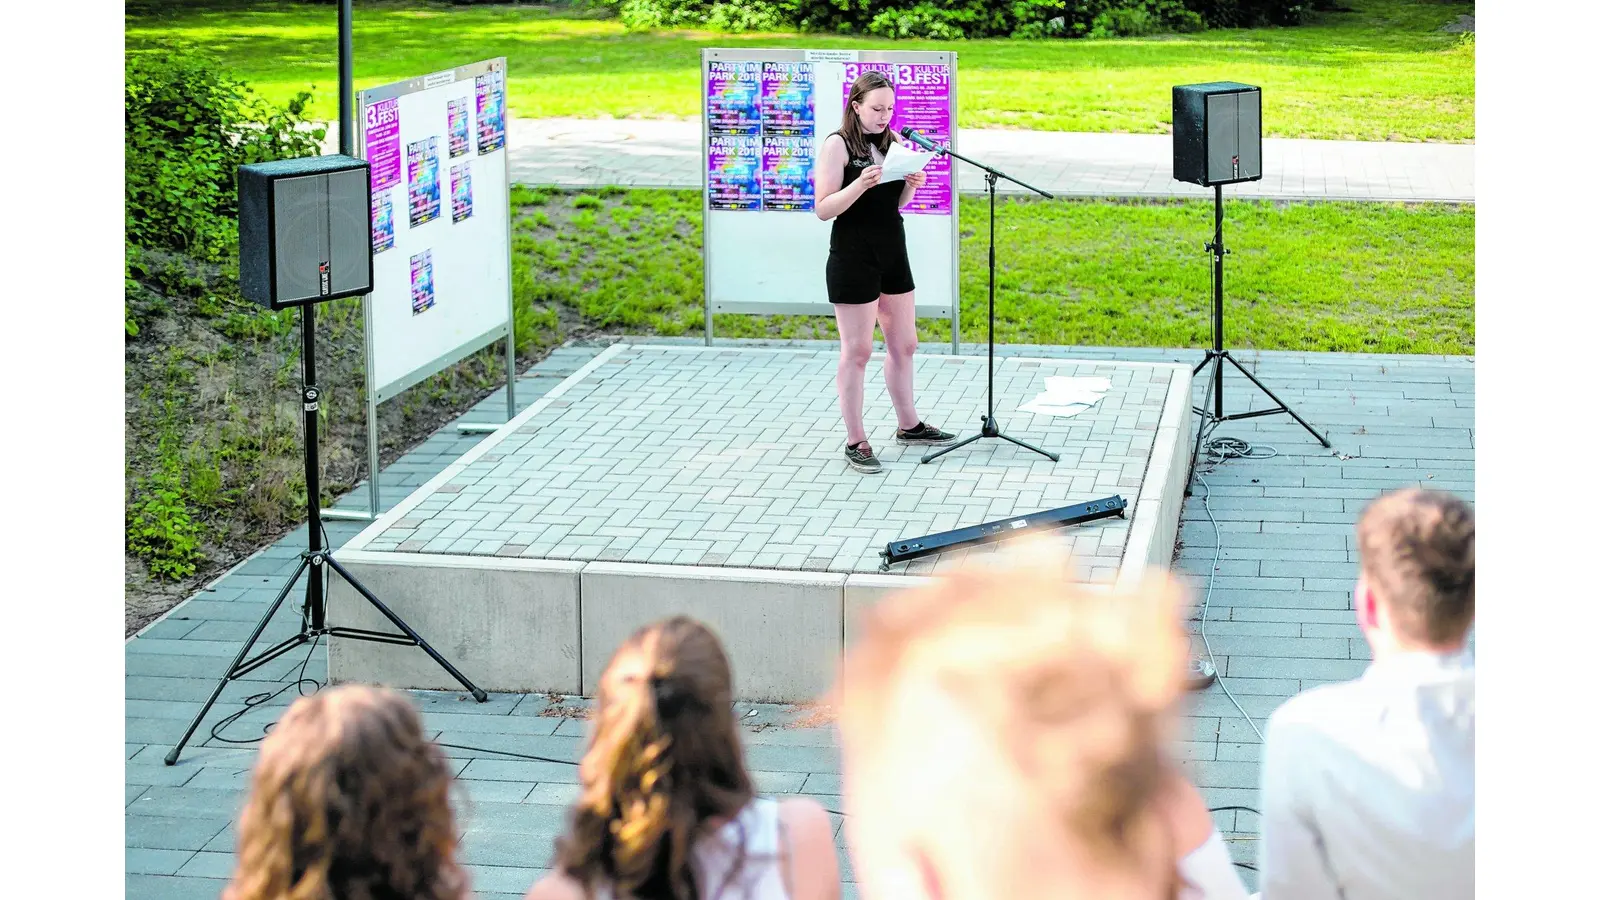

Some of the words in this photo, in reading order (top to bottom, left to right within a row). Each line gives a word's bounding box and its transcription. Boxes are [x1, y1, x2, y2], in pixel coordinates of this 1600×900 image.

[712, 62, 745, 72] PARTY
[746, 64, 760, 72] IM
[765, 63, 798, 72] PARTY
[798, 64, 813, 72] IM
[916, 66, 950, 74] KULTUR
[709, 72, 735, 81] PARK
[738, 72, 761, 81] 2018
[763, 72, 789, 81] PARK
[792, 73, 815, 82] 2018
[916, 74, 950, 84] FEST
[378, 108, 400, 125] FEST
[712, 138, 745, 146] PARTY
[746, 138, 760, 146] IM
[765, 138, 798, 146] PARTY
[798, 138, 813, 146] IM
[709, 146, 735, 156] PARK
[738, 147, 761, 156] 2018
[763, 147, 789, 156] PARK
[792, 147, 815, 156] 2018
